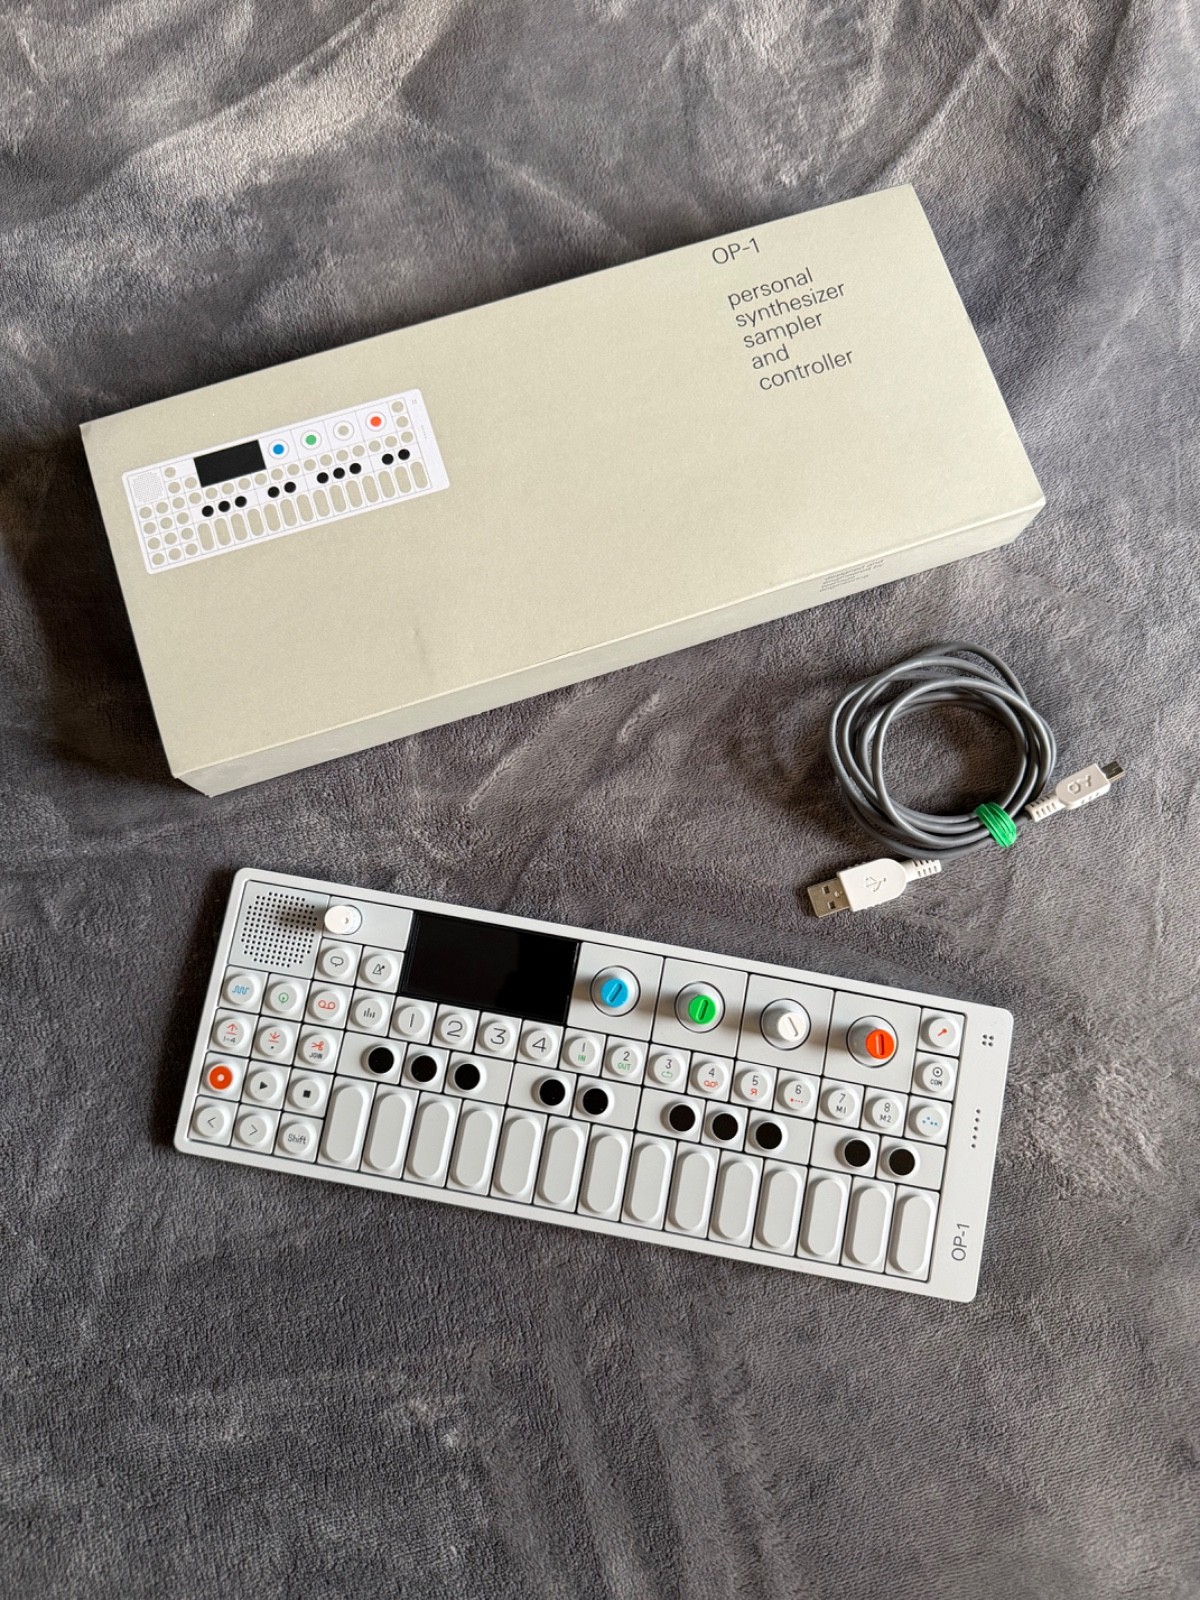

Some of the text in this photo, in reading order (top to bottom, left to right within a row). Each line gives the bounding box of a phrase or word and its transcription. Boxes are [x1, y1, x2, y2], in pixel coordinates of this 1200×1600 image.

[712, 238, 760, 264] OP-1
[727, 267, 813, 310] personal
[735, 283, 845, 327] synthesizer
[743, 313, 822, 349] sampler
[751, 343, 790, 370] and
[759, 351, 853, 391] controller
[447, 1020, 463, 1037] 2
[490, 1027, 507, 1045] 3
[532, 1037, 547, 1053] 4
[623, 1051, 631, 1062] 2
[617, 1062, 632, 1071] OUT
[665, 1059, 673, 1069] 3
[708, 1068, 715, 1078] 4
[752, 1075, 759, 1086] 5
[795, 1084, 802, 1095] 6
[839, 1093, 846, 1103] 7
[836, 1105, 847, 1114] M1
[883, 1102, 891, 1113] 8
[879, 1113, 892, 1123] M2
[287, 1133, 307, 1145] Shift
[951, 1223, 970, 1262] OP-1
